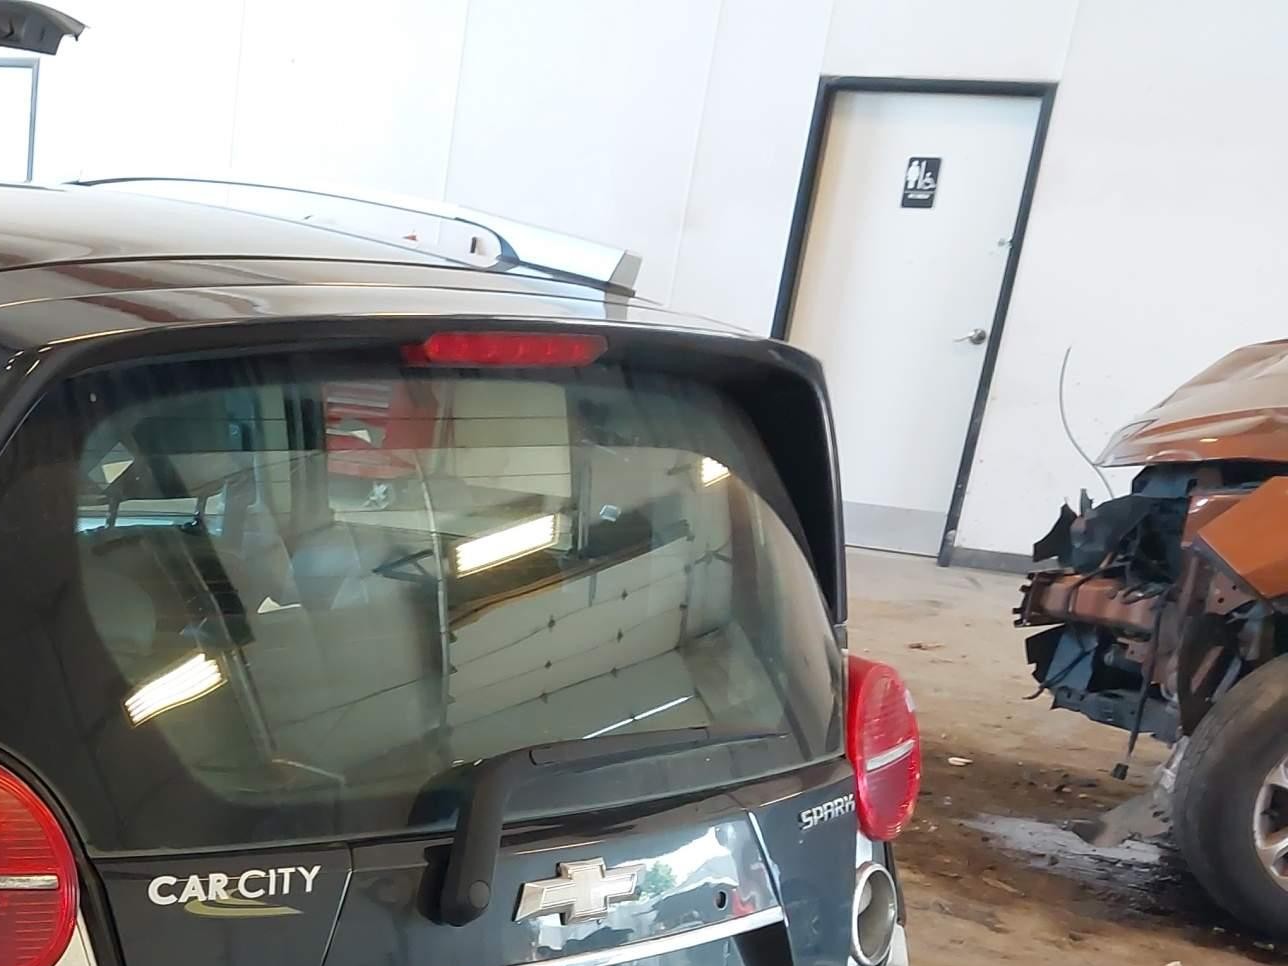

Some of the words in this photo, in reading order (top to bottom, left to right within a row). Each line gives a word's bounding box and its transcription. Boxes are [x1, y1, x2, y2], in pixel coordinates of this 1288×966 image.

[800, 793, 856, 830] SPARK
[147, 872, 230, 906] CAR
[237, 864, 322, 899] CITY
